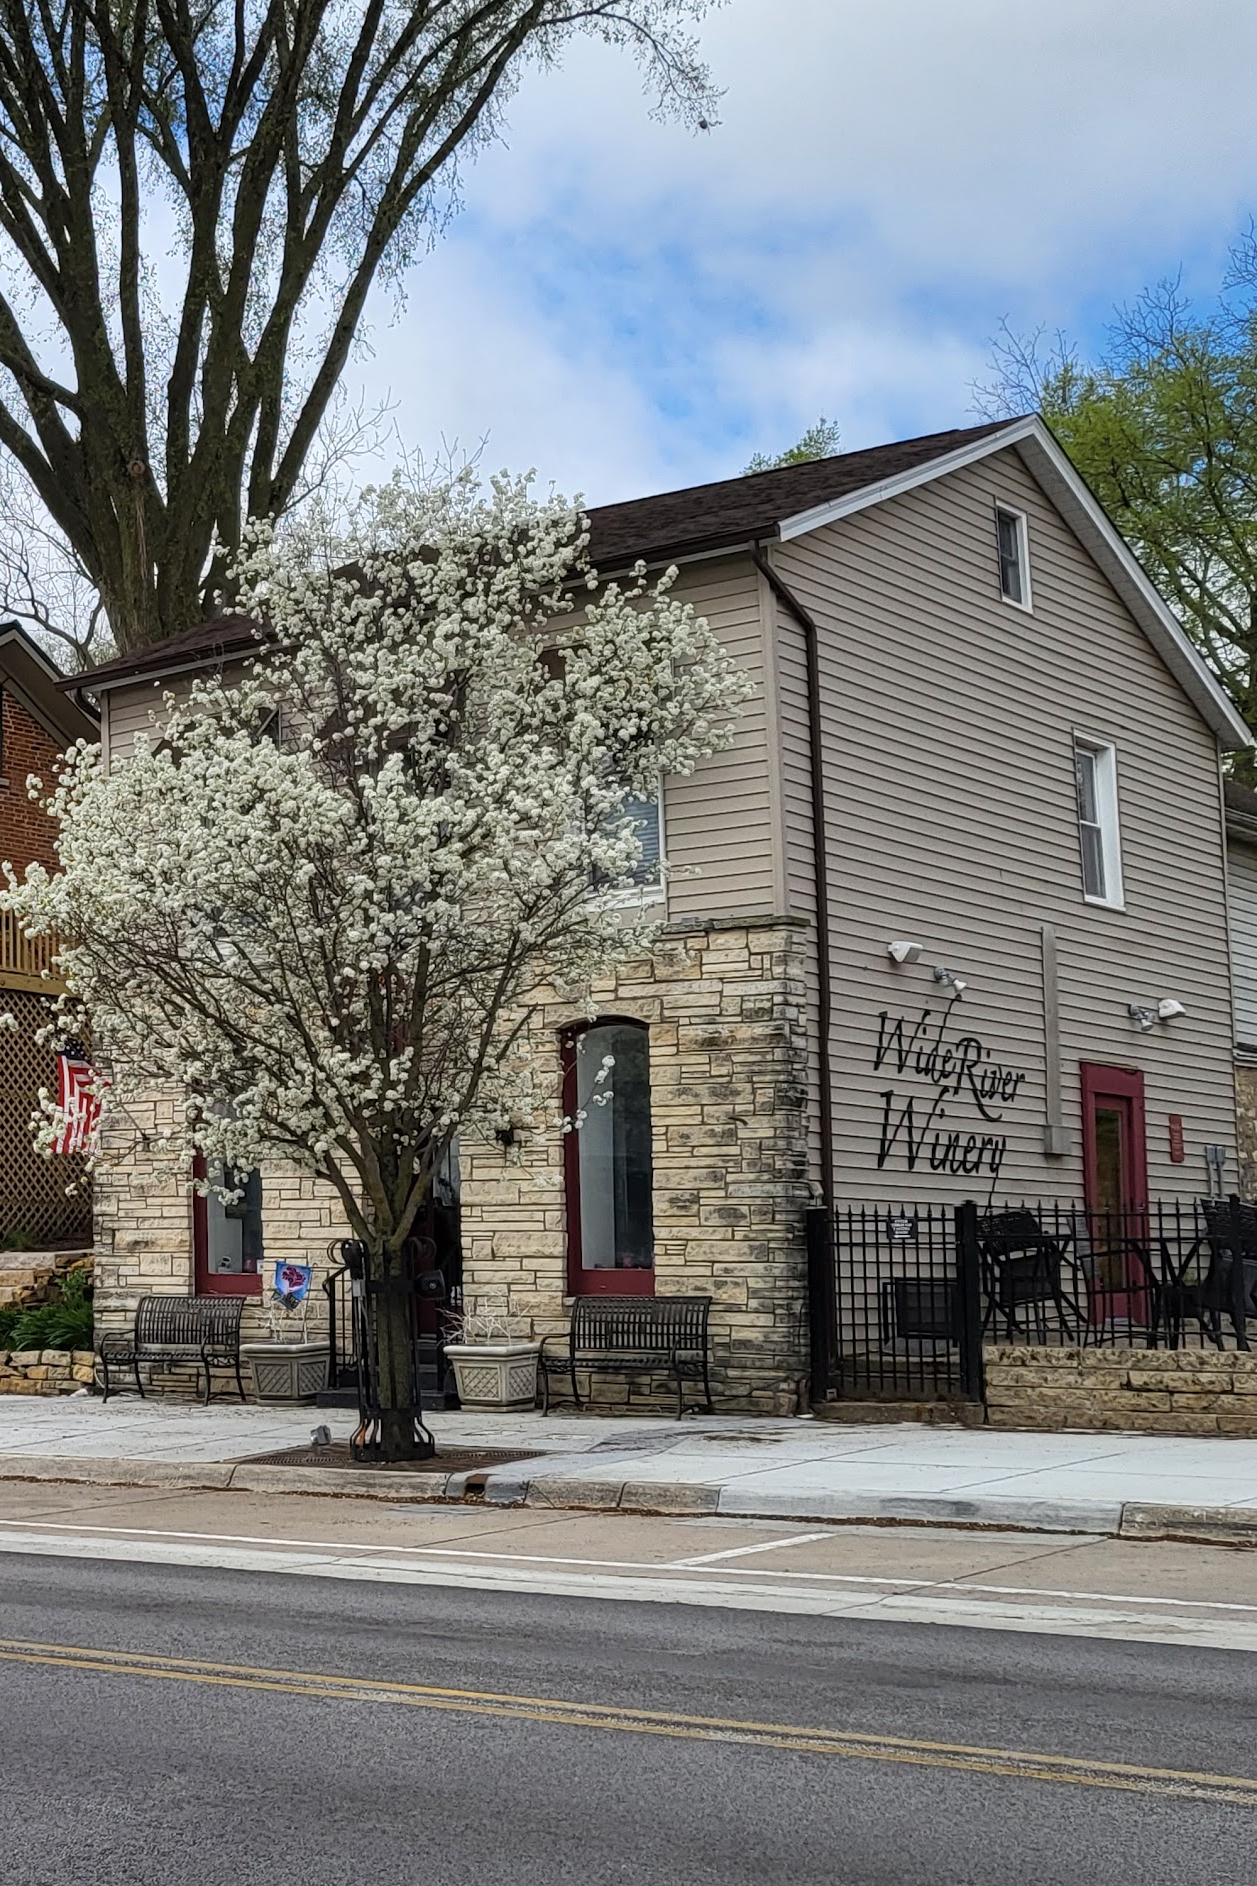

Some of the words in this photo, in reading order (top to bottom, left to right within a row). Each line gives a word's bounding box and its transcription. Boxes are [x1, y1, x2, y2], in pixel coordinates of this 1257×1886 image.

[873, 993, 962, 1084] Wide
[954, 1037, 1026, 1122] River
[877, 1086, 1007, 1216] Winery
